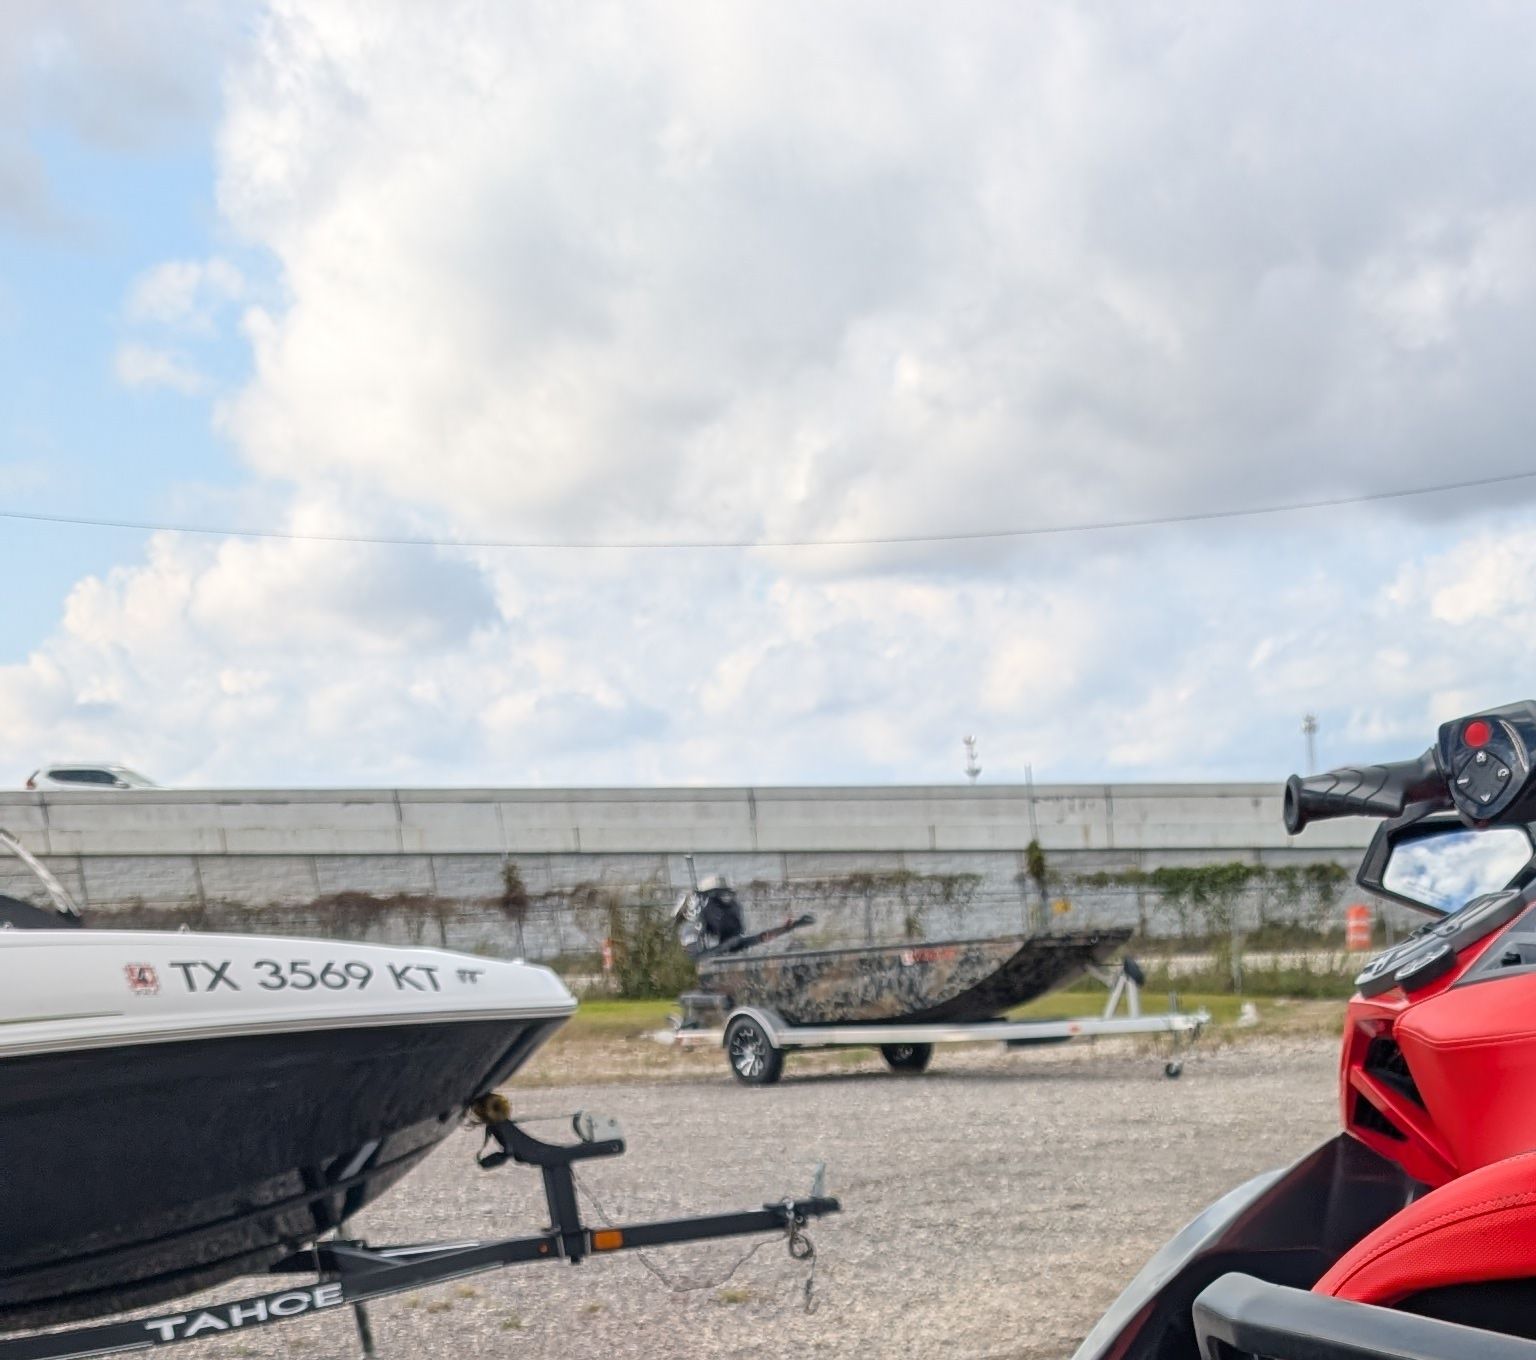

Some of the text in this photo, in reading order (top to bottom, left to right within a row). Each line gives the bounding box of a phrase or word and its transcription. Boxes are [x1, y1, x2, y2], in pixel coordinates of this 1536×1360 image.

[170, 960, 240, 992] TX
[253, 959, 372, 991] 3569
[388, 963, 438, 992] KT
[144, 1282, 344, 1341] TAHOE
